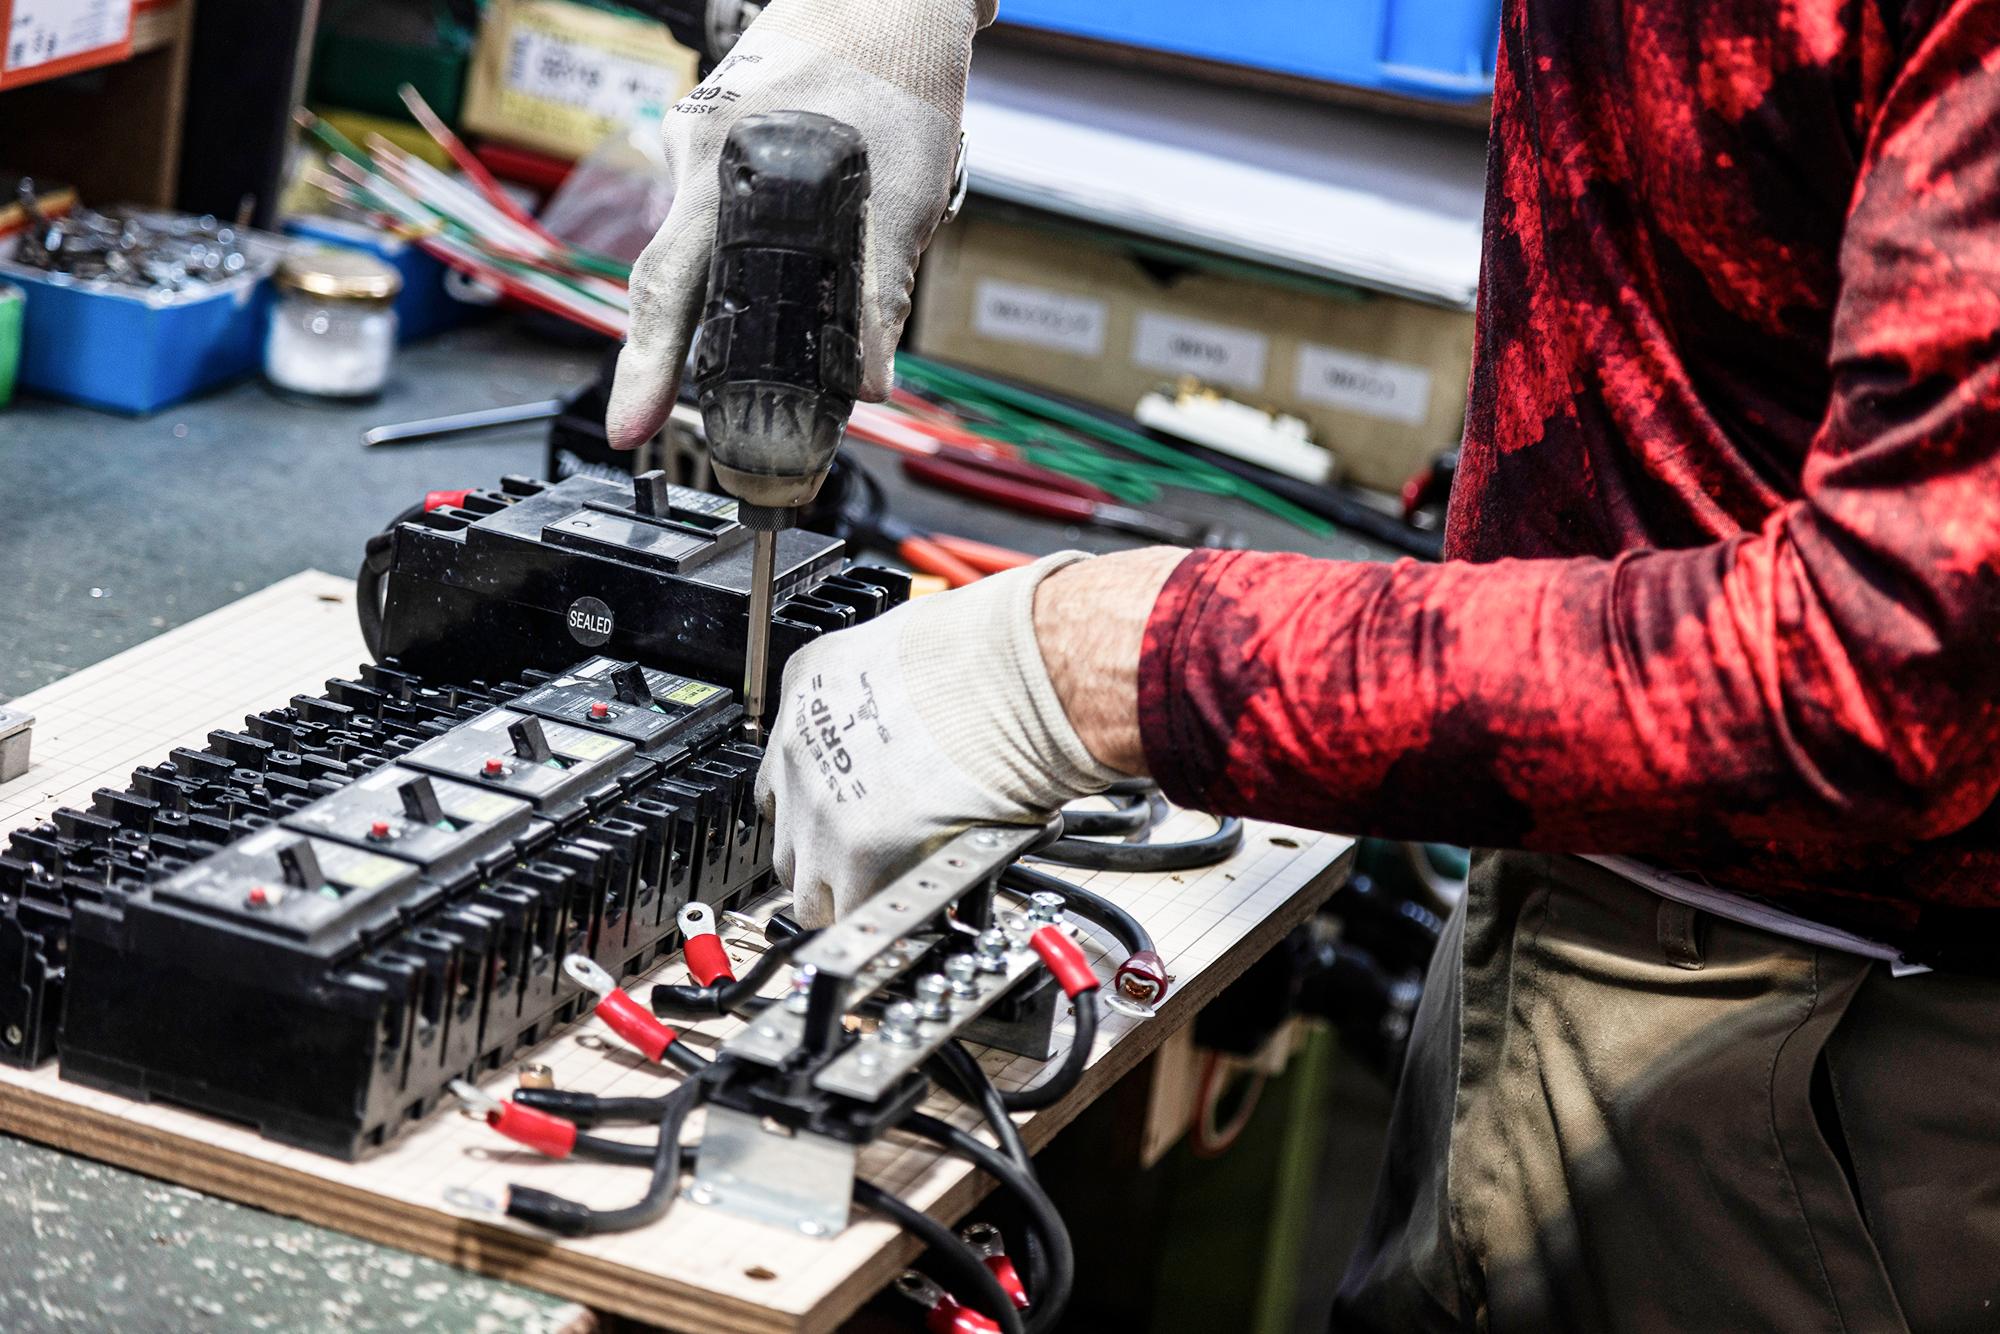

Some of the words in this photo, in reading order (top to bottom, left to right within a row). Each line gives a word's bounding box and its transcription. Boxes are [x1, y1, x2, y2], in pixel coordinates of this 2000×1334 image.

[569, 610, 612, 635] SEALED
[811, 698, 852, 774] GRIP
[842, 713, 856, 731] L
[796, 693, 848, 803] ASSEMBLY
